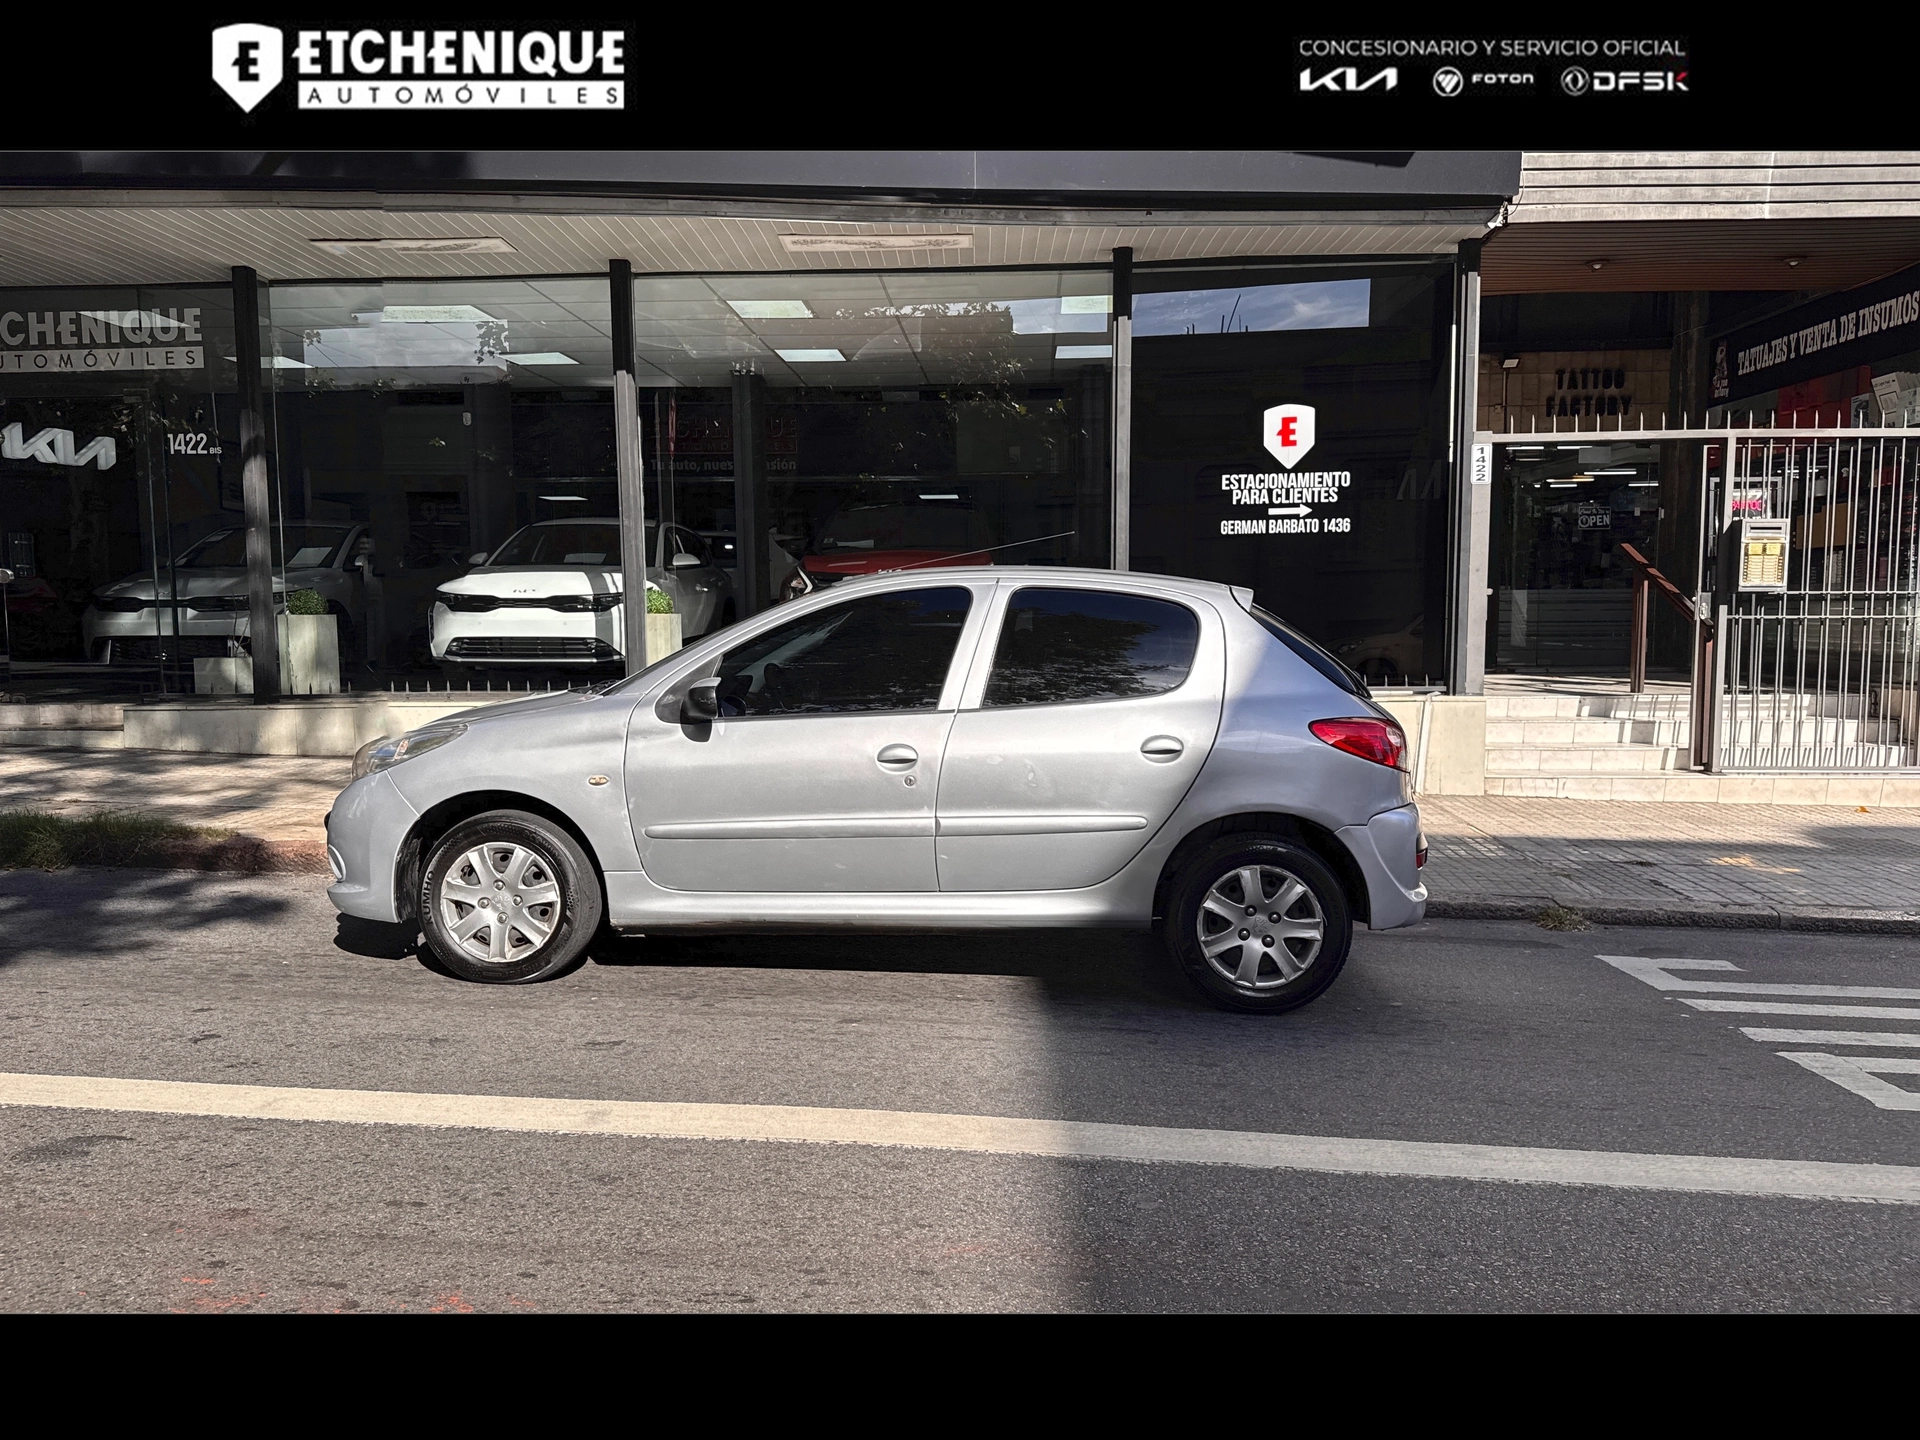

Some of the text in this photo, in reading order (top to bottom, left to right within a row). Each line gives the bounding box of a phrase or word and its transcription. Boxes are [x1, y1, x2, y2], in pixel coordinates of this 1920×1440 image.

[1738, 290, 1920, 376] TATUAJES Y VENTA DE INSUMOS
[1555, 368, 1625, 390] TATTOO
[1545, 396, 1632, 418] FACTORY
[1276, 416, 1298, 447] E
[1, 422, 117, 470] KIA
[167, 433, 222, 455] 1422 BIS
[1475, 446, 1487, 482] 1422
[1221, 471, 1351, 490] ESTACIONAMIENTO
[1232, 487, 1339, 505] PARA CLIENTES
[1220, 518, 1351, 535] GERMAN BARBATO 1436
[1578, 514, 1610, 528] OPEN
[423, 870, 434, 925] KUMHO
